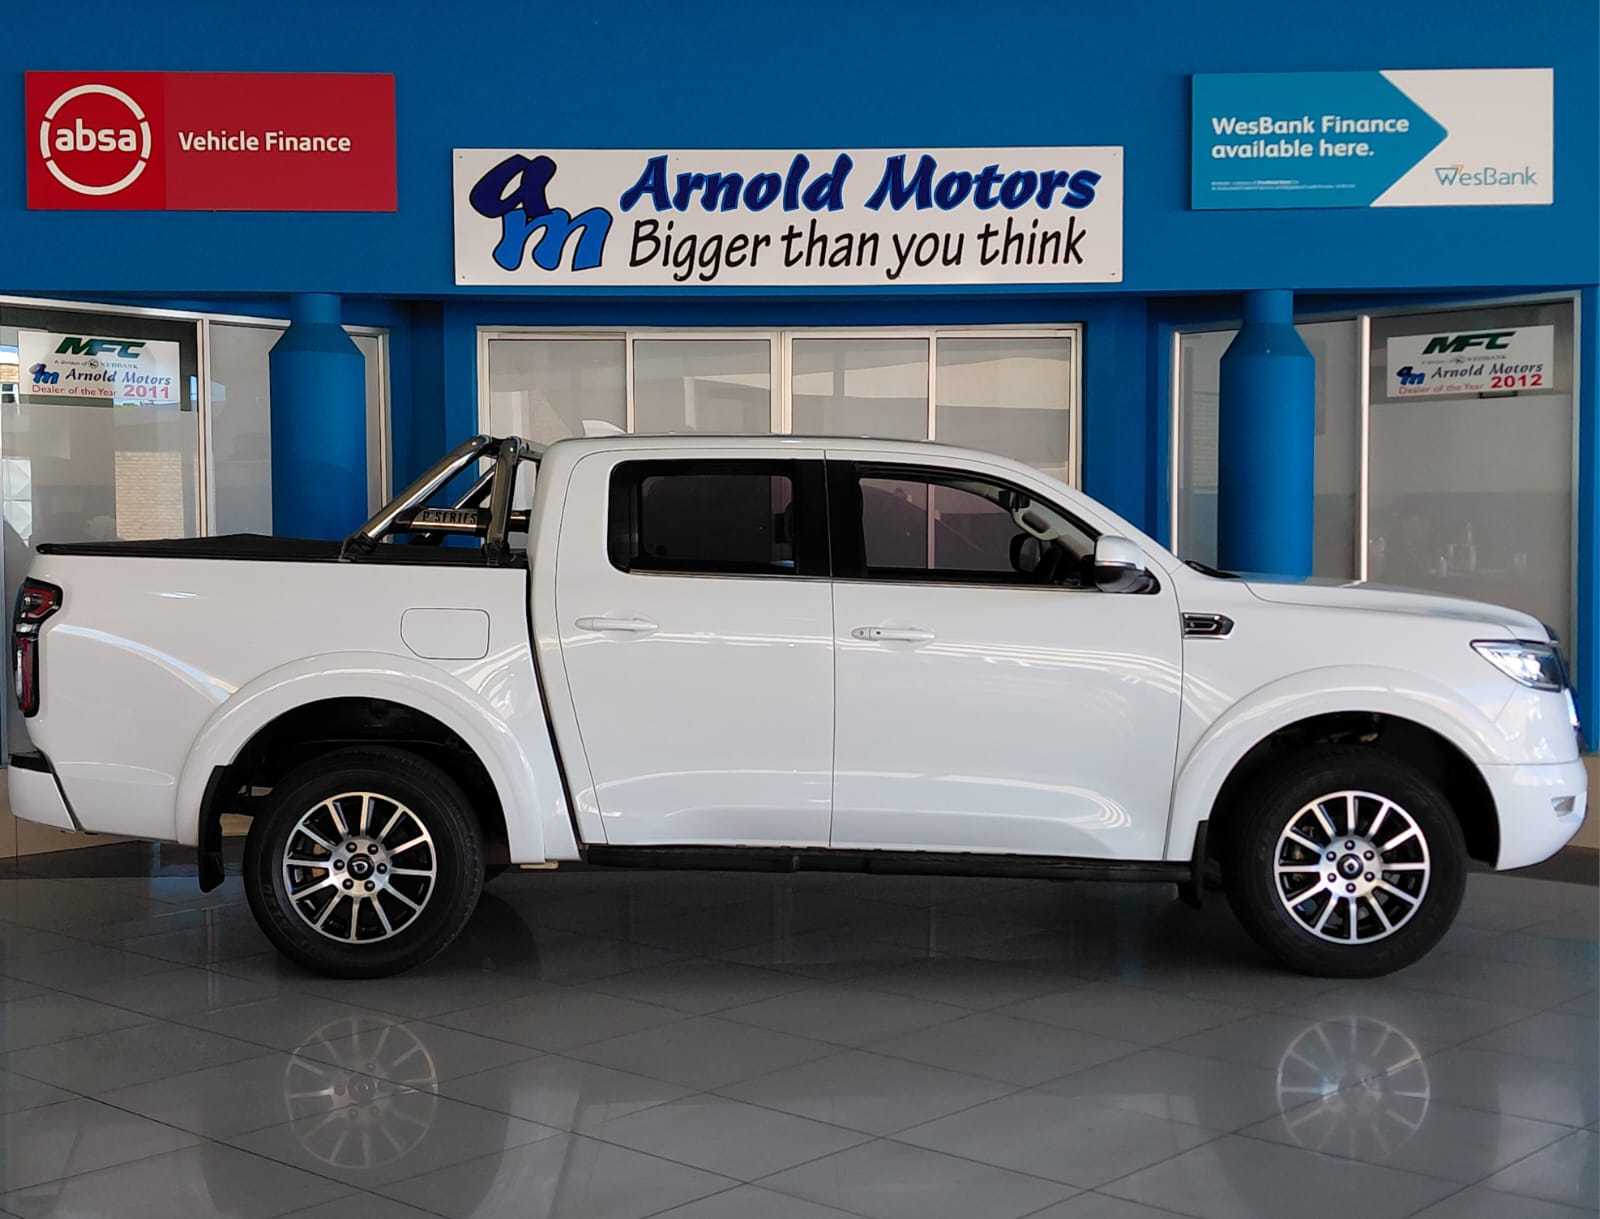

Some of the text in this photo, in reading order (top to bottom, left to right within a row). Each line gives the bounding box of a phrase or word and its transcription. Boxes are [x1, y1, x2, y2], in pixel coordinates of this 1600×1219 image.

[55, 118, 137, 152] absa
[1211, 115, 1410, 136] WesBank Finance
[178, 131, 351, 152] Vehicle Finance
[1211, 138, 1375, 159] available here.
[619, 153, 1102, 212] Arnold Motors
[1434, 164, 1537, 186] WesBank
[629, 215, 1086, 282] Bigger than you think
[55, 337, 146, 358] MFC
[1422, 331, 1516, 355] MFC
[65, 368, 171, 385] Arnold Motors
[1431, 363, 1544, 379] Arnold Motors
[32, 384, 169, 399] Dealer of the Year 2011
[1400, 374, 1543, 395] Dealer of the Year 2012
[434, 511, 477, 524] SERIES
